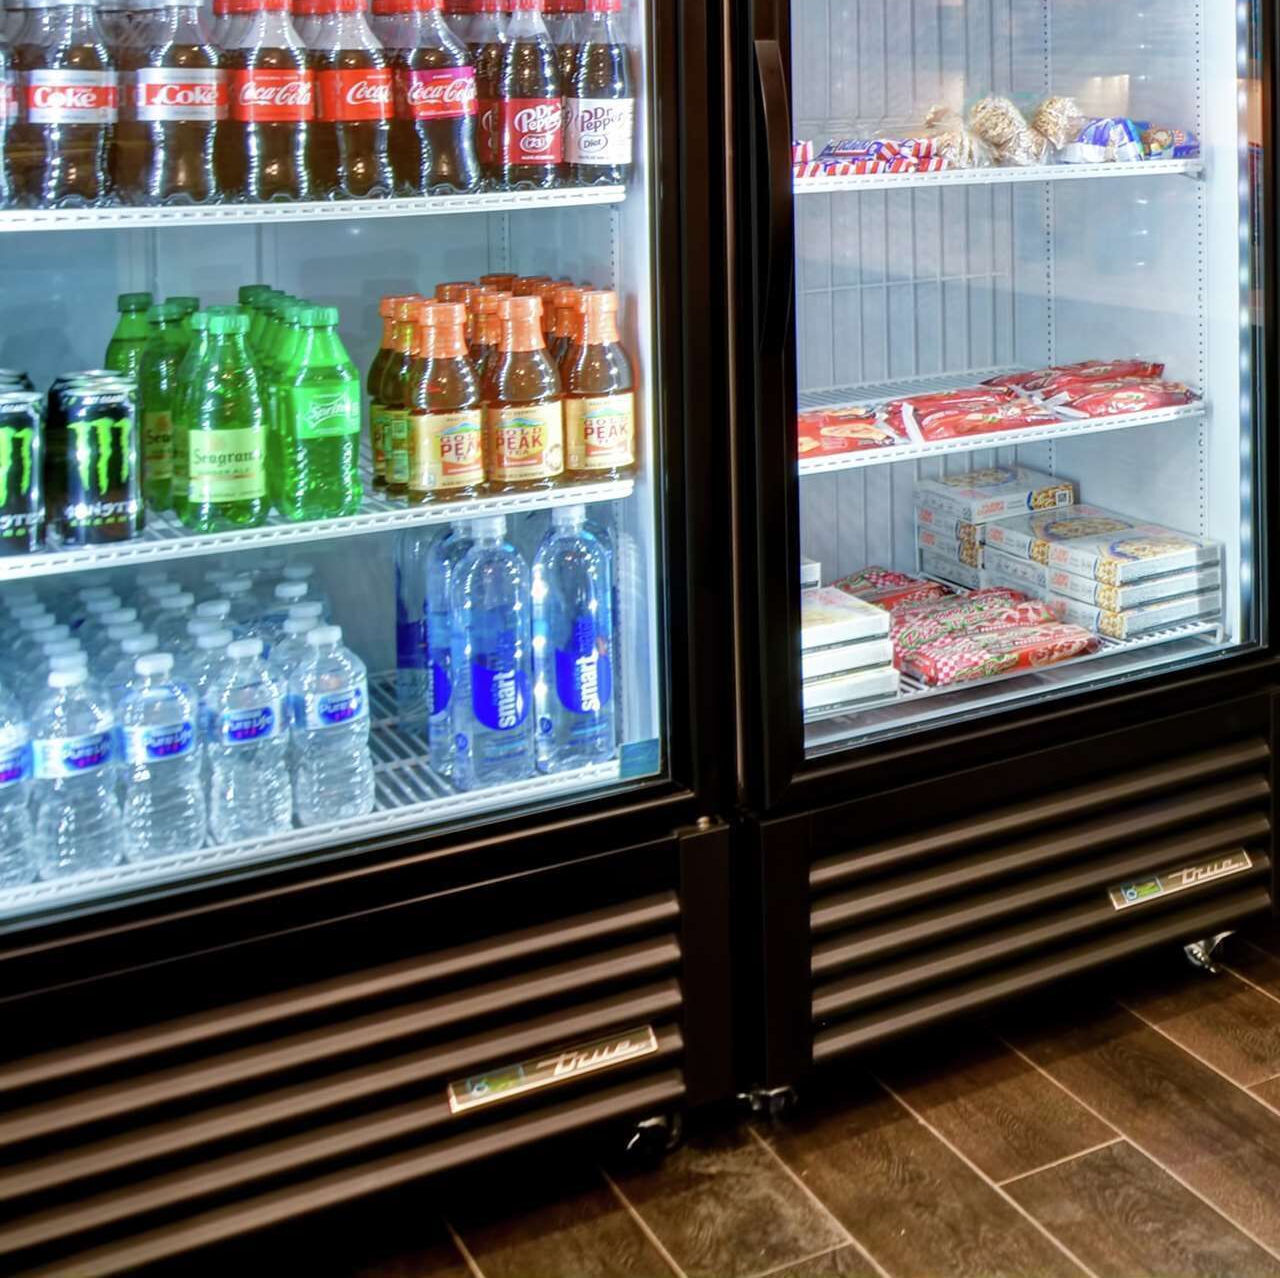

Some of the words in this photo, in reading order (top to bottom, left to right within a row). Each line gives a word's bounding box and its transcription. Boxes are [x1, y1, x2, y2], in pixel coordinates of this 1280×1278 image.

[33, 85, 98, 108] Coke
[154, 84, 218, 105] Coke
[239, 80, 312, 106] Coca-Cola
[407, 77, 478, 106] Coca-Cola
[593, 106, 613, 121] Dr
[583, 136, 602, 149] Diet
[495, 434, 543, 451] PEAK
[583, 424, 628, 441] PEAK
[575, 653, 600, 713] smart
[496, 669, 517, 729] smart
